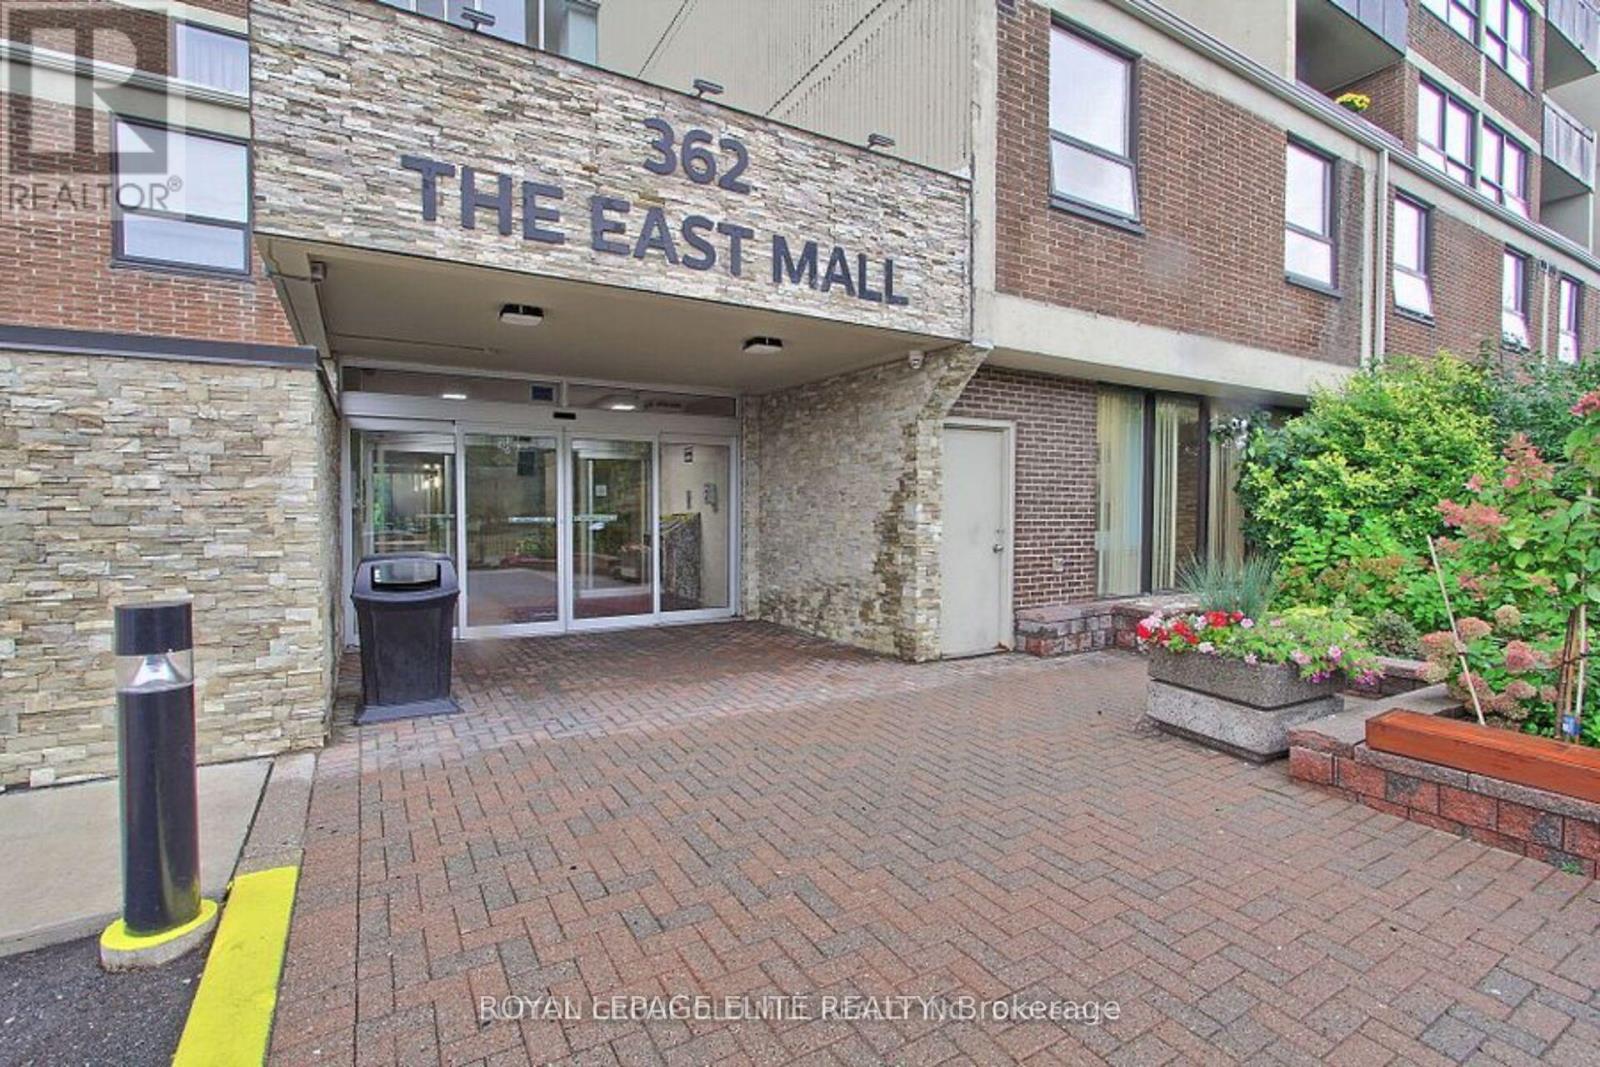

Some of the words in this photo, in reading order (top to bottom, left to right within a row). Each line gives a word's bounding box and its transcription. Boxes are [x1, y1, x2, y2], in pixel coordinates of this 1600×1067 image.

[642, 117, 751, 196] 362
[400, 154, 565, 246] THE
[591, 194, 755, 278] EAST
[772, 234, 910, 306] MALL
